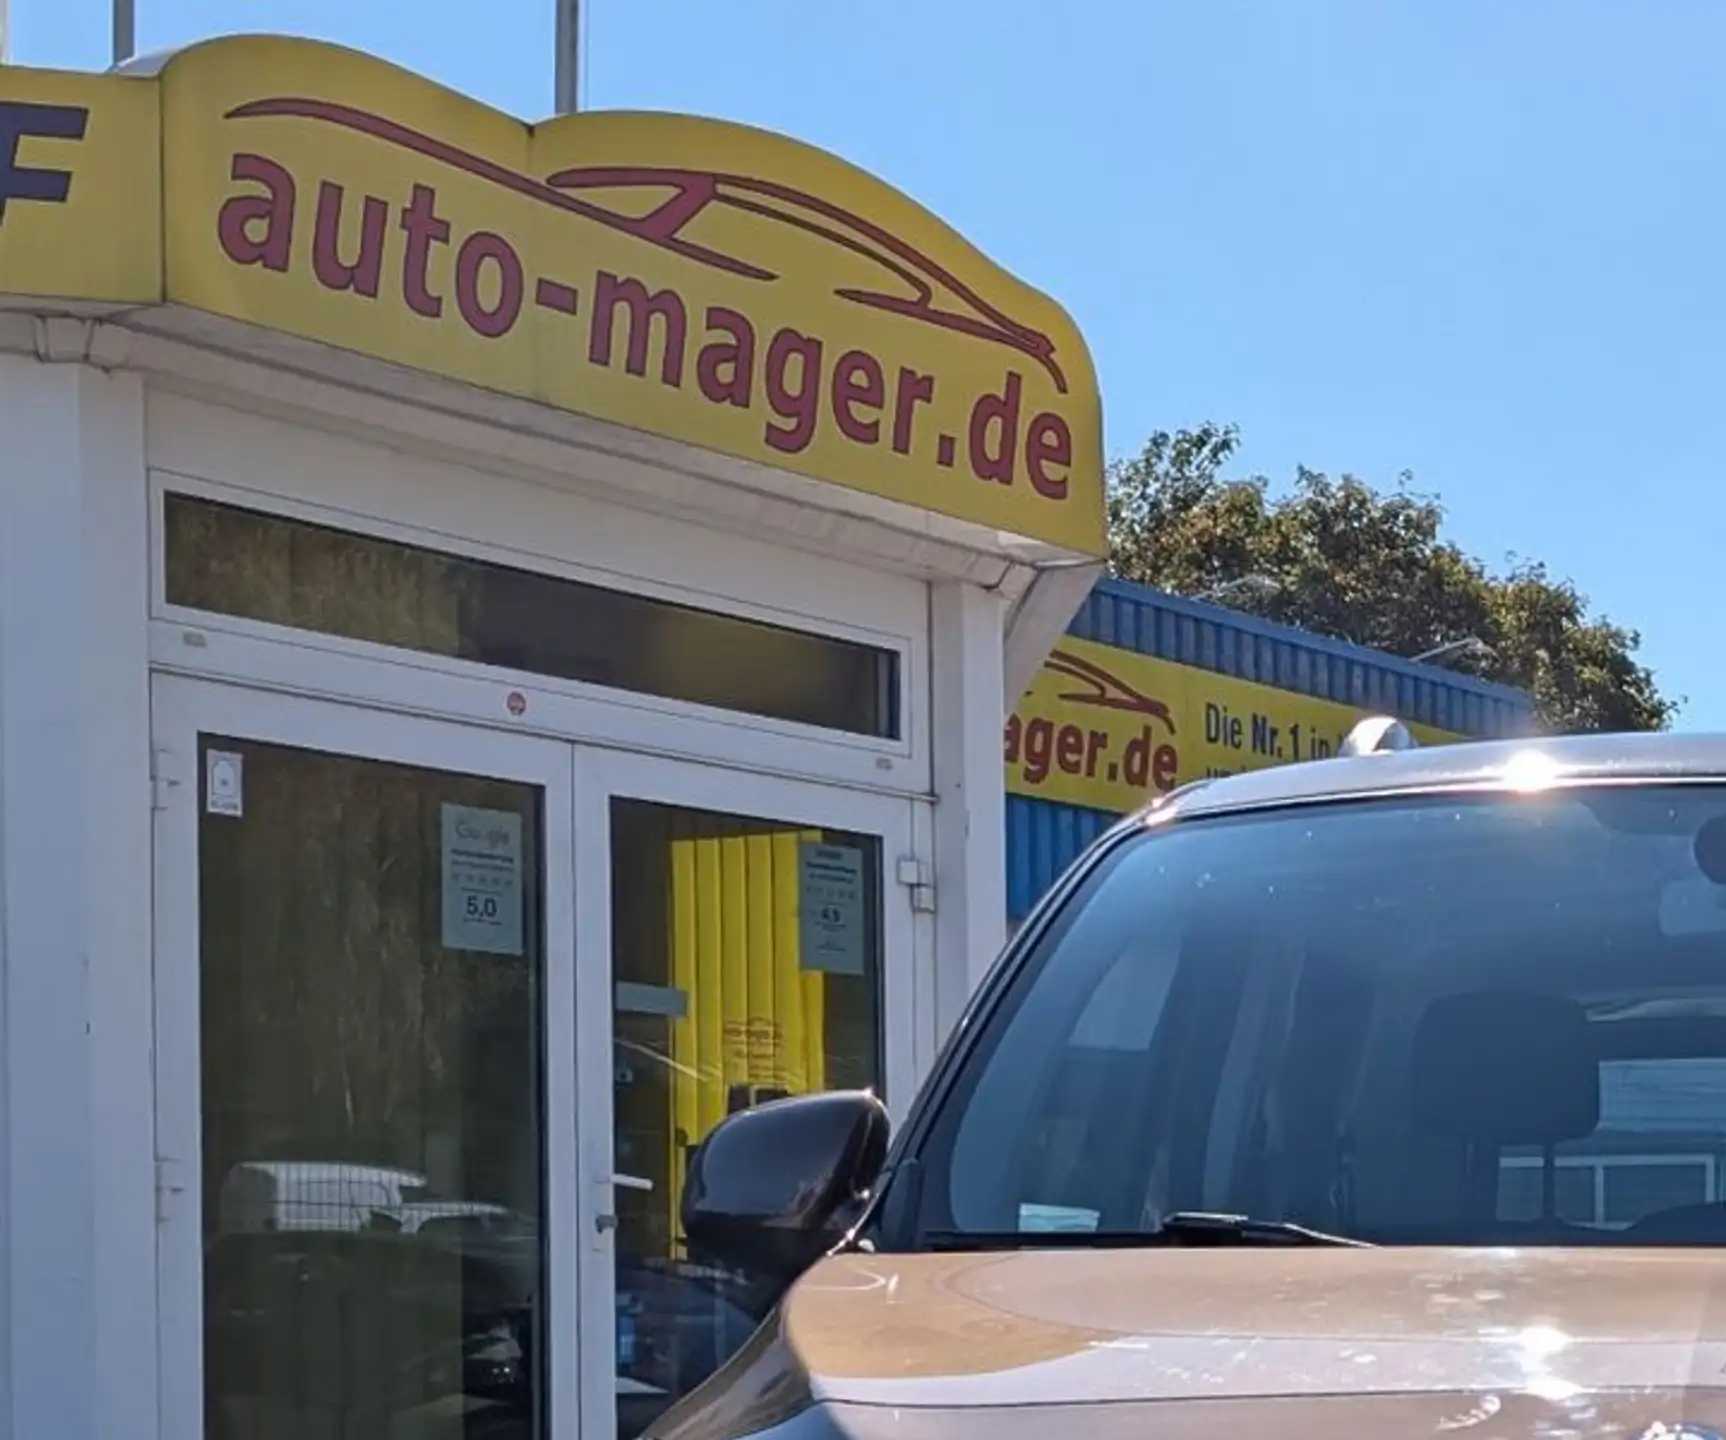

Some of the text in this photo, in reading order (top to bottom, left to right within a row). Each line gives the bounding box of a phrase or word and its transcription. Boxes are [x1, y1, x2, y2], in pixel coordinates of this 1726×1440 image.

[217, 153, 1074, 500] auto-mager.de
[1206, 702, 1243, 750] Die
[1252, 712, 1283, 758] Nr.
[1290, 722, 1300, 762] 1
[467, 895, 498, 918] 5,0
